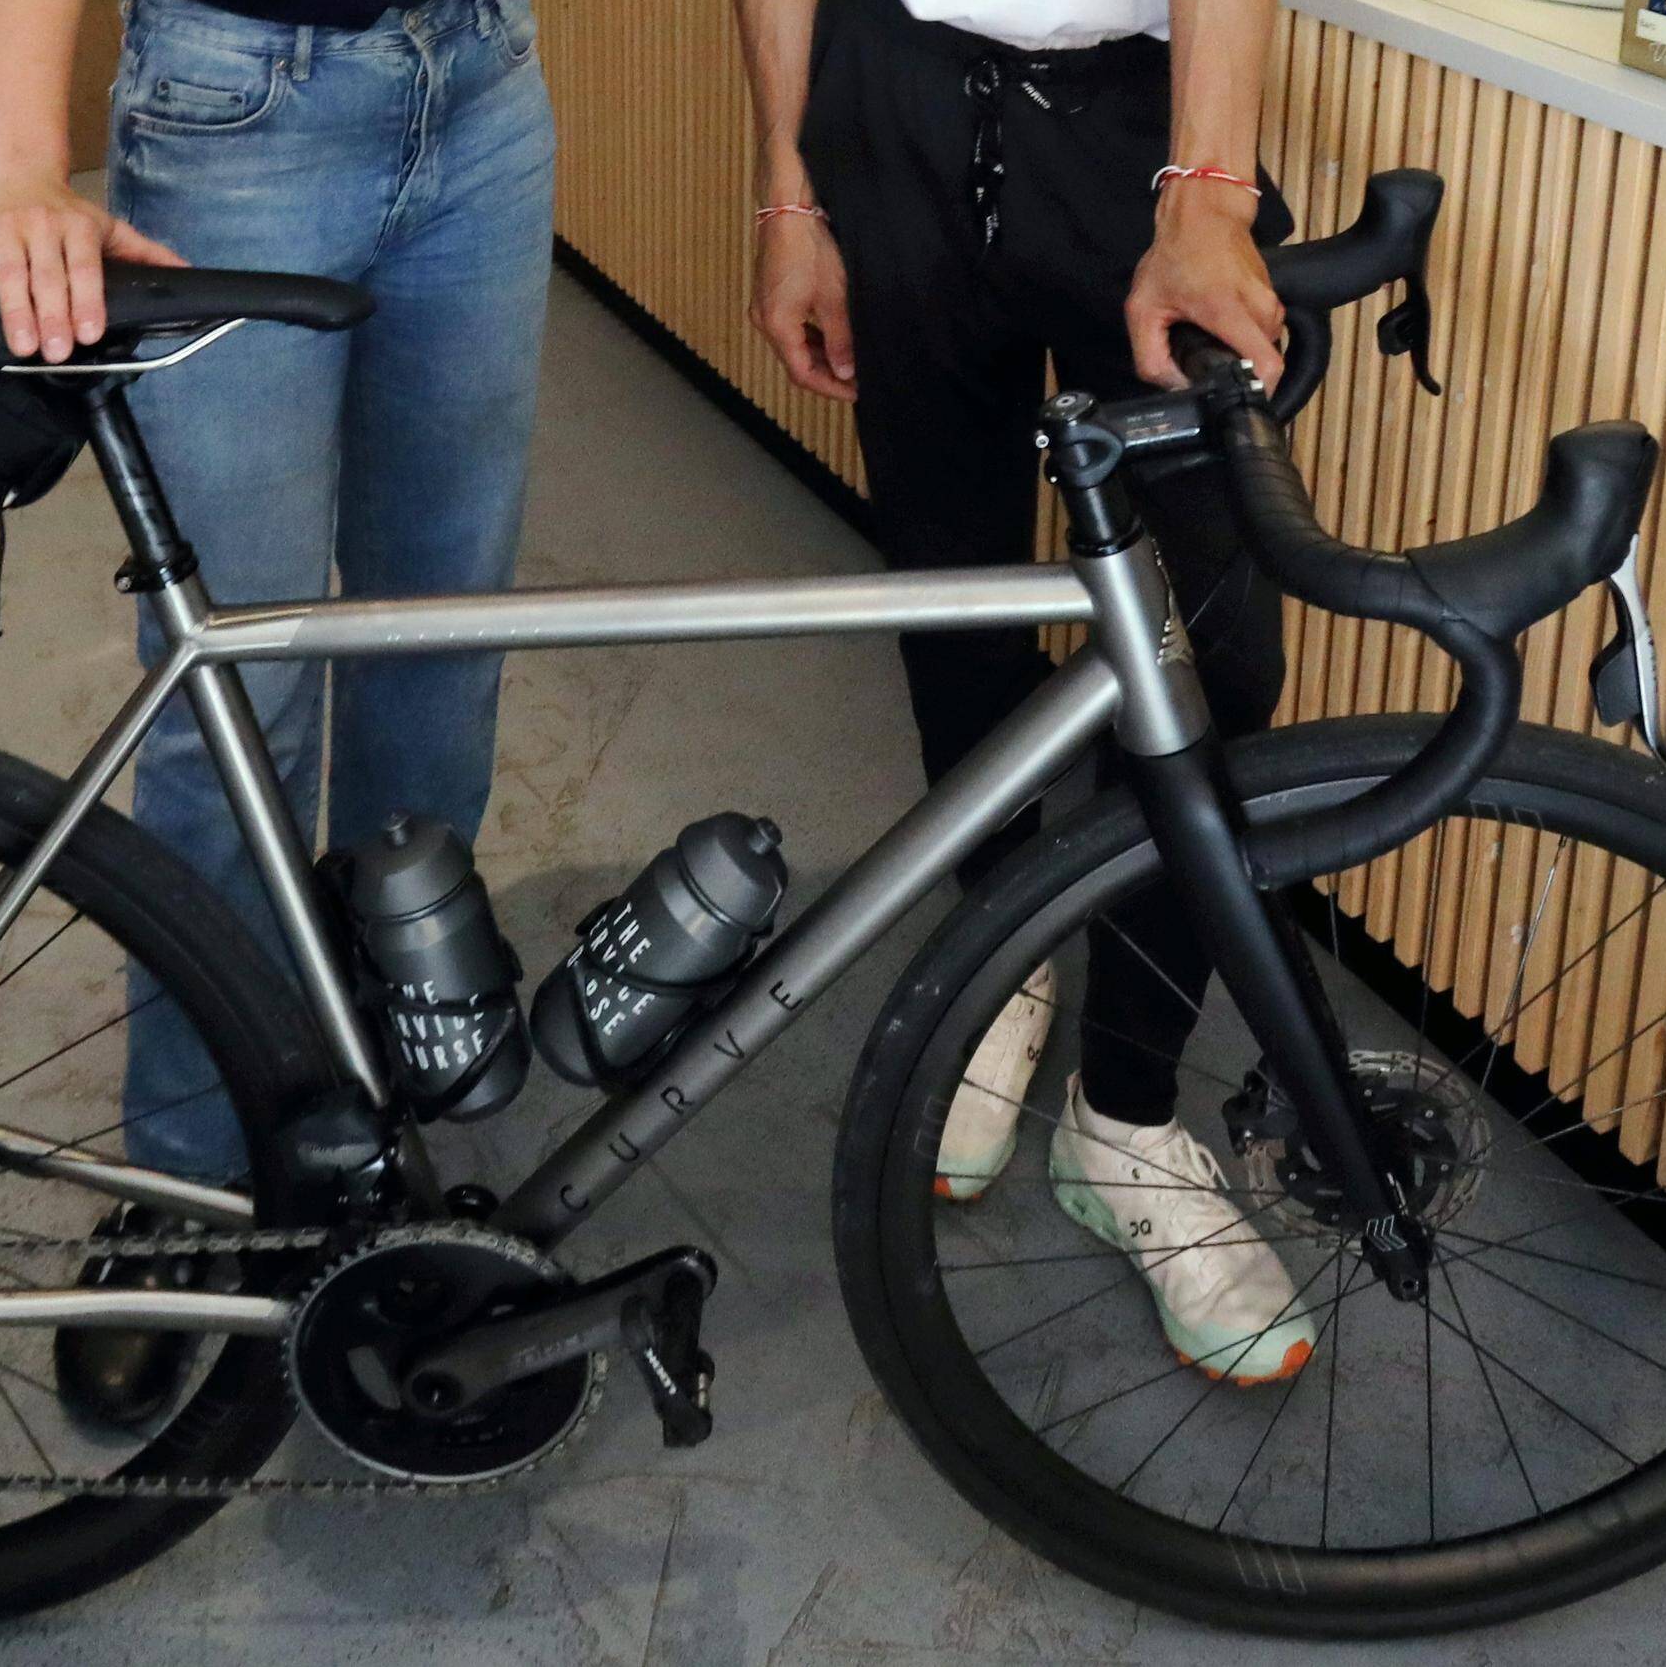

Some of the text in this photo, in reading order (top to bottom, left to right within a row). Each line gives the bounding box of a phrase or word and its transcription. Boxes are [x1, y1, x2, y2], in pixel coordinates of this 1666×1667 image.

[589, 914, 656, 1016] ERVICE
[613, 901, 653, 965] THE
[388, 980, 440, 1006] HE
[560, 979, 805, 1213] CURVE
